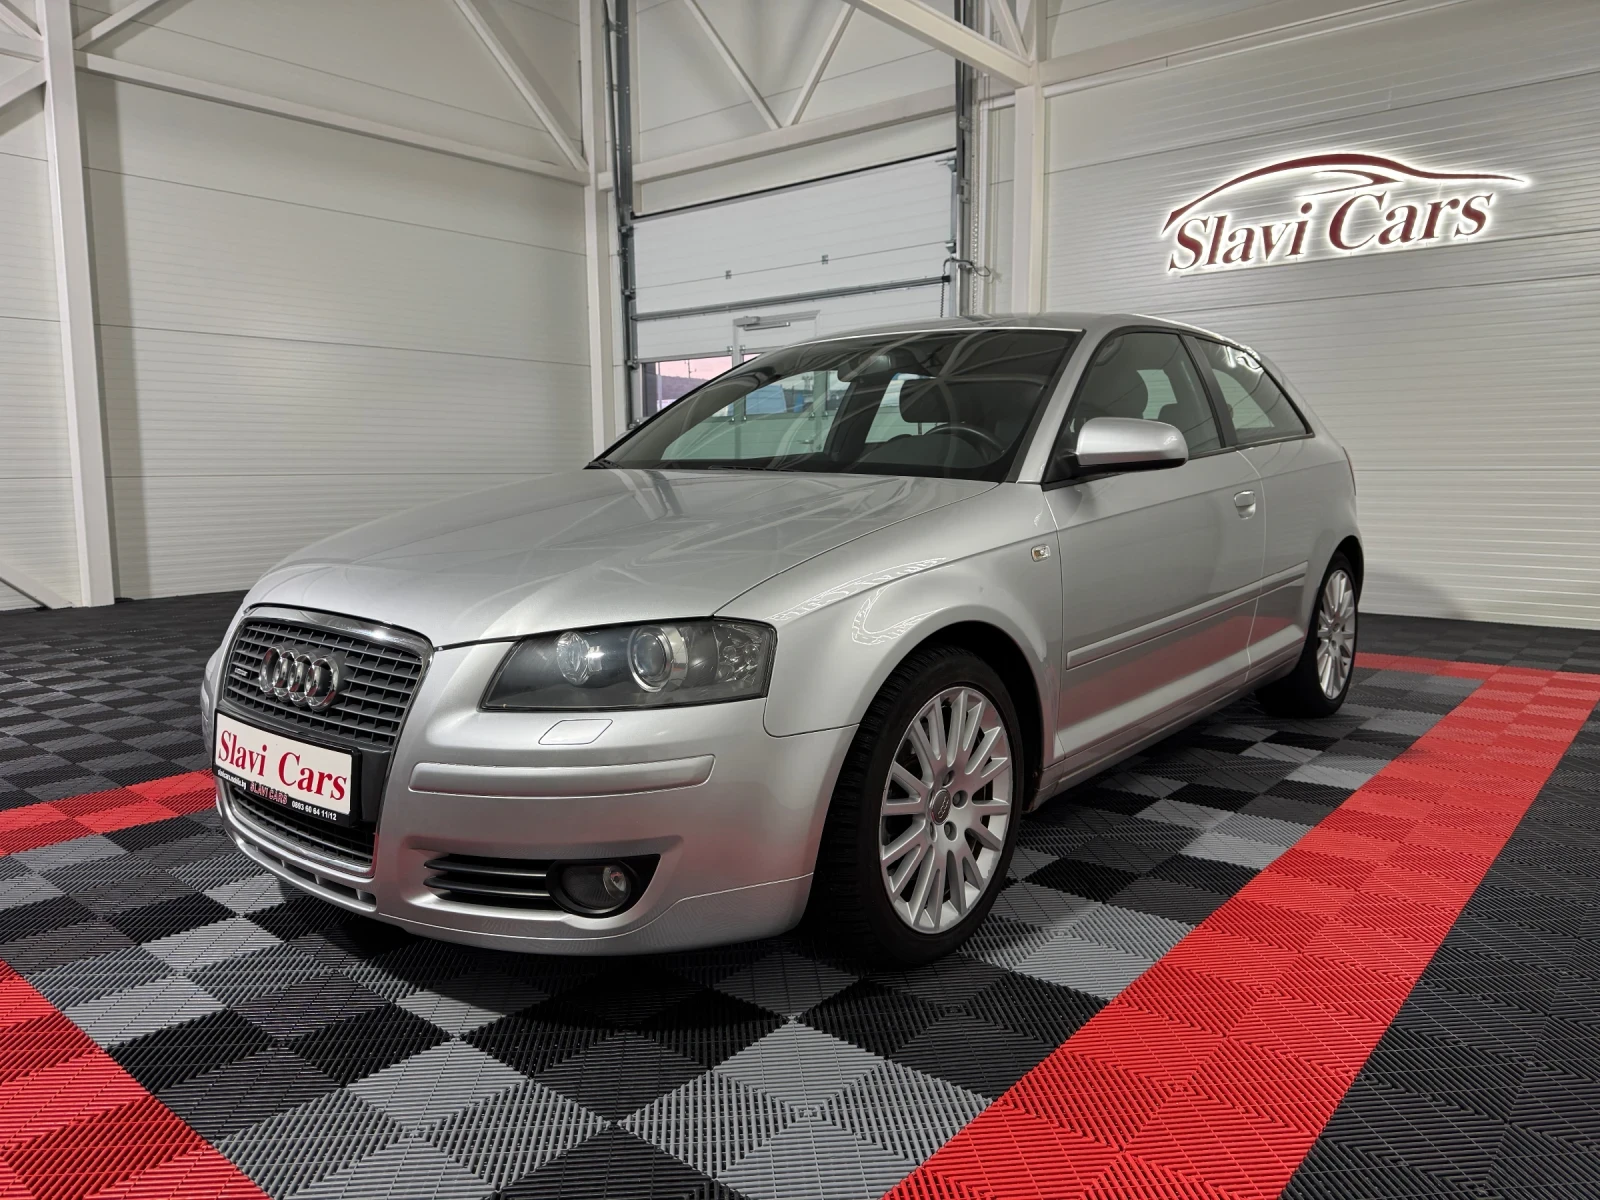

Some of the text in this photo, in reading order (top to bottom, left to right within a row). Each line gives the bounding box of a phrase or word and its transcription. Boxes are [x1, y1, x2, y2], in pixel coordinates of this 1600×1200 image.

[1168, 191, 1494, 273] Slavi Cars
[218, 730, 348, 801] Slavi Cars
[249, 781, 269, 798] SLAVI
[268, 789, 288, 805] CARS
